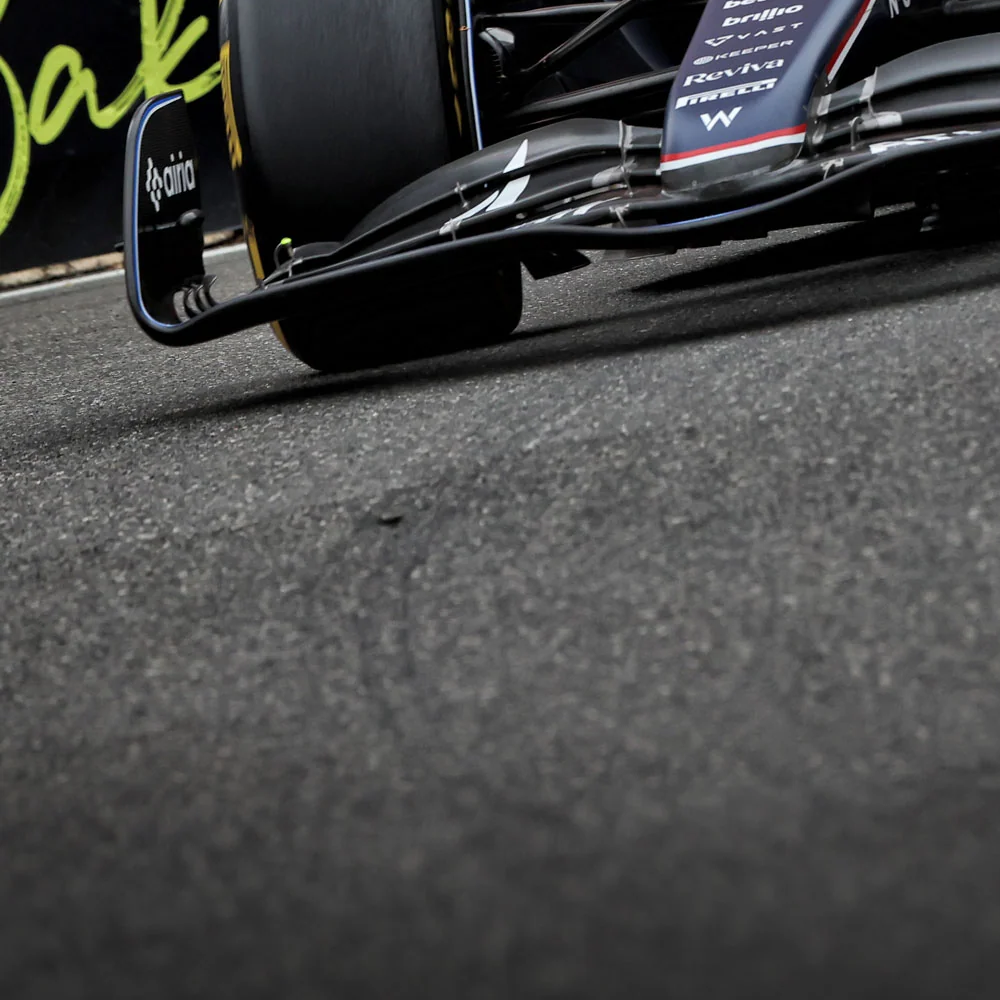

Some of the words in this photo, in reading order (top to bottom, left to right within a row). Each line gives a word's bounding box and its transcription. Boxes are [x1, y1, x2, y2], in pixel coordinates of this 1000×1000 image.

[721, 4, 804, 28] brillio
[737, 21, 804, 40] VAST
[714, 39, 794, 62] KEEPER
[683, 58, 785, 88] Reviva
[675, 77, 779, 110] PIRELLI
[163, 149, 197, 198] airia
